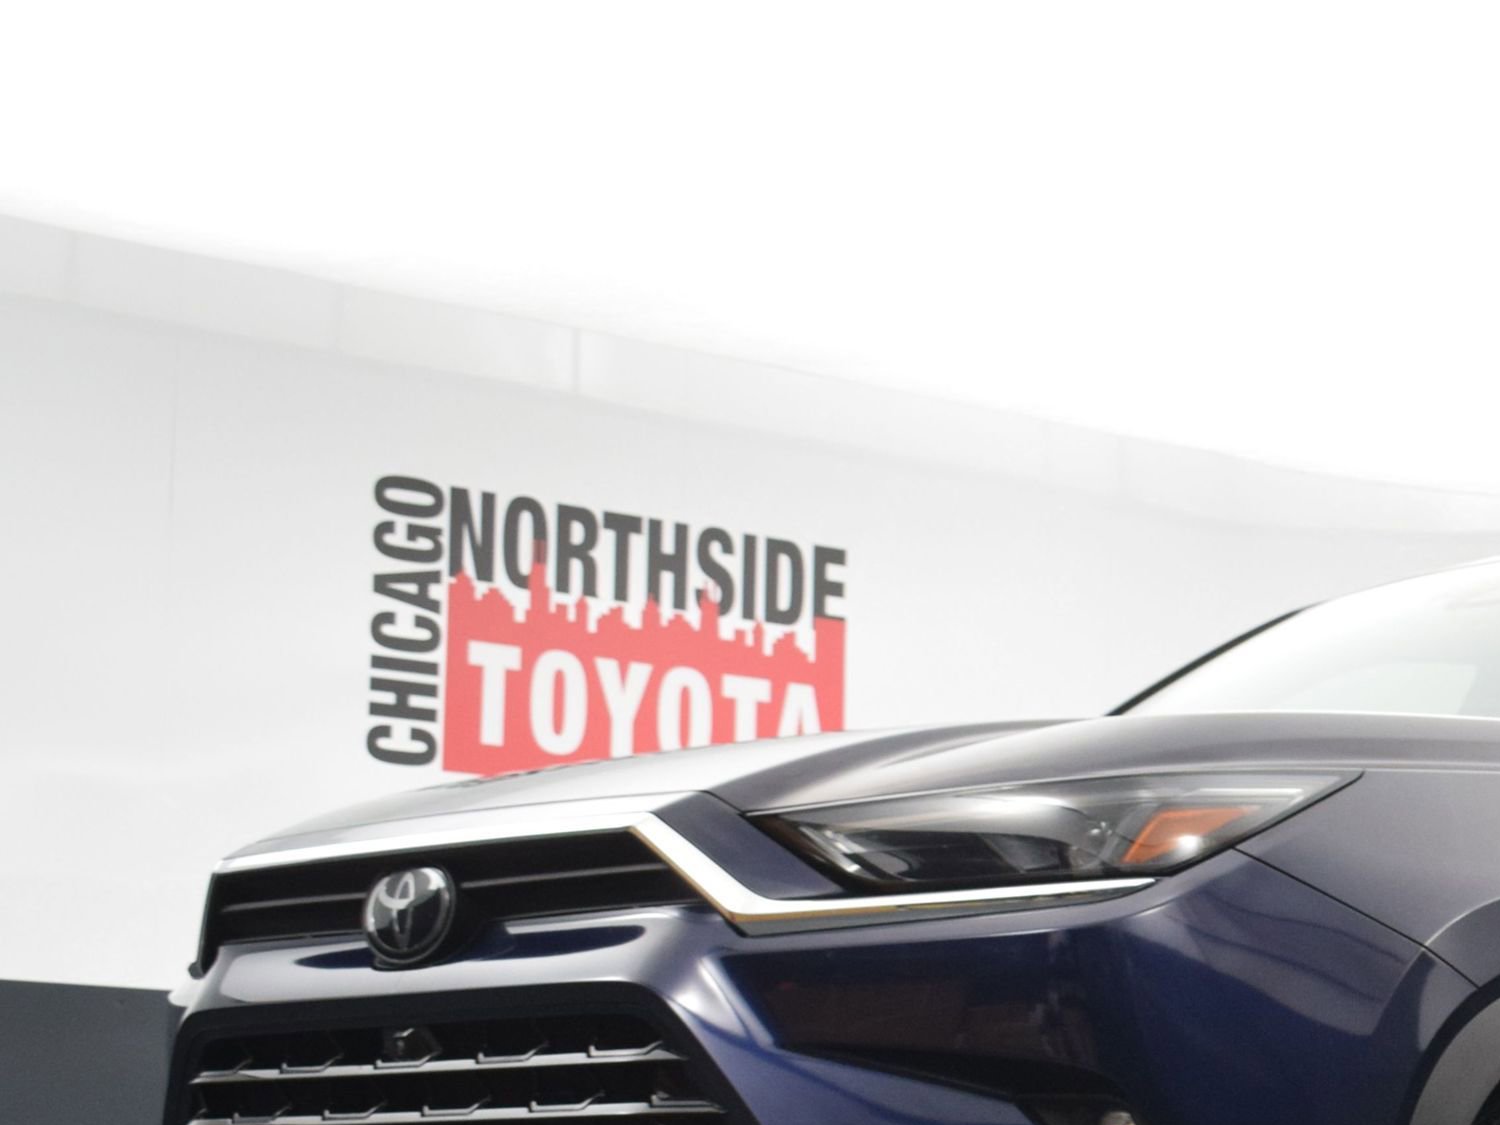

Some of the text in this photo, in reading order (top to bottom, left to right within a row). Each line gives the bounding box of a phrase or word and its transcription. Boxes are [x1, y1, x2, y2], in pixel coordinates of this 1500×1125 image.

[366, 474, 444, 767] CHICAGO
[448, 485, 847, 626] NORTHSIDE
[467, 639, 821, 758] TOYOTA
